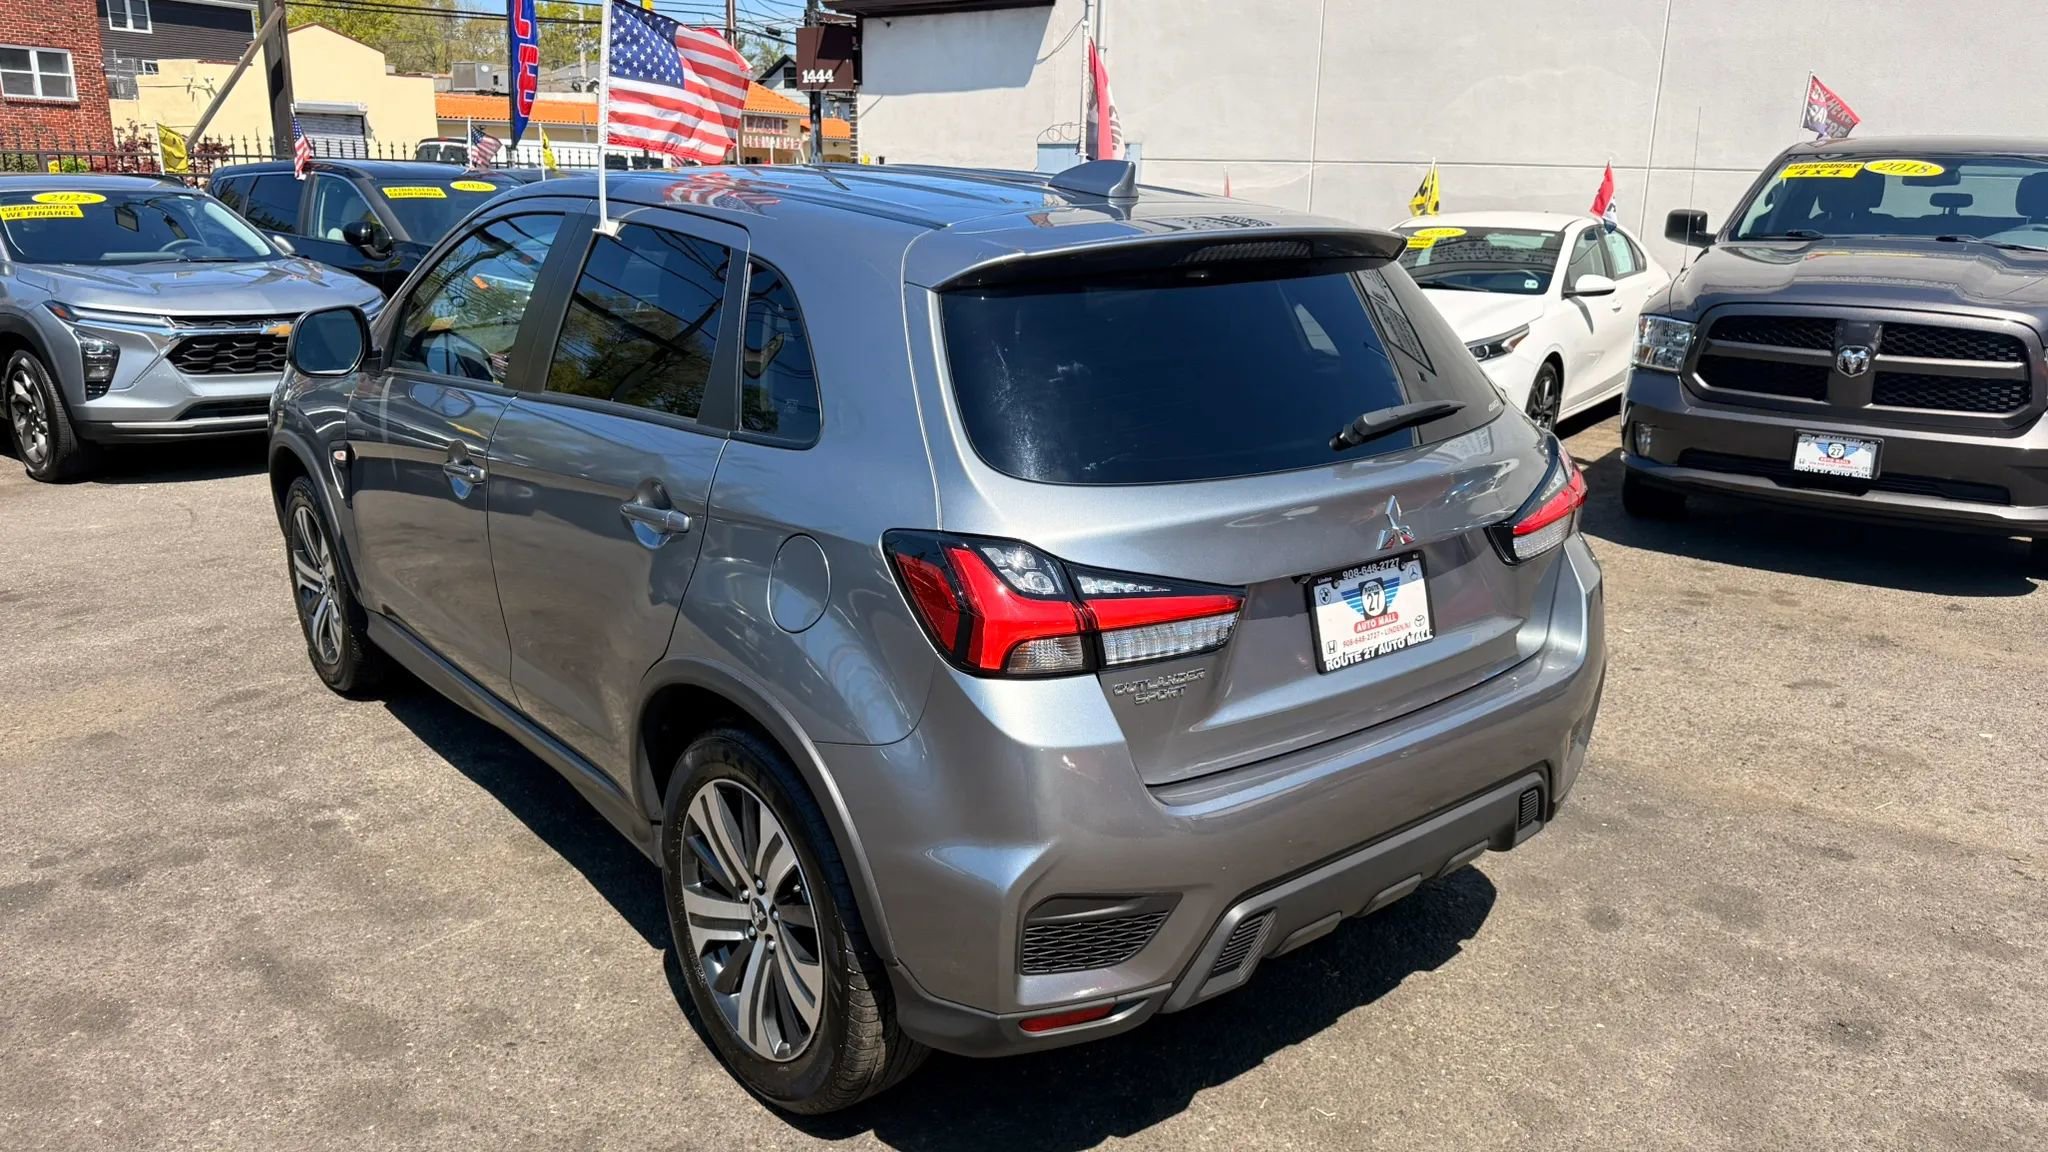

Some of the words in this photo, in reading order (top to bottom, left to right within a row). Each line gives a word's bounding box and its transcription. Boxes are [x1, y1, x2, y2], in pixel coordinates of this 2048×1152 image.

[802, 68, 834, 83] 1444
[1875, 163, 1932, 174] 2018
[48, 194, 92, 202] 2025
[1830, 448, 1842, 456] 27
[1342, 558, 1400, 580] 908-648-2727
[1364, 584, 1380, 593] ROUTE
[1366, 592, 1381, 612] 27
[1356, 619, 1376, 632] AUTO
[1378, 614, 1397, 628] MALL
[1326, 652, 1363, 672] ROUTE
[1363, 647, 1377, 660] 27
[1378, 638, 1406, 654] AUTO
[1407, 629, 1434, 646] MALL
[1113, 668, 1206, 696] OUTLANDER
[1135, 684, 1187, 705] SPORT
